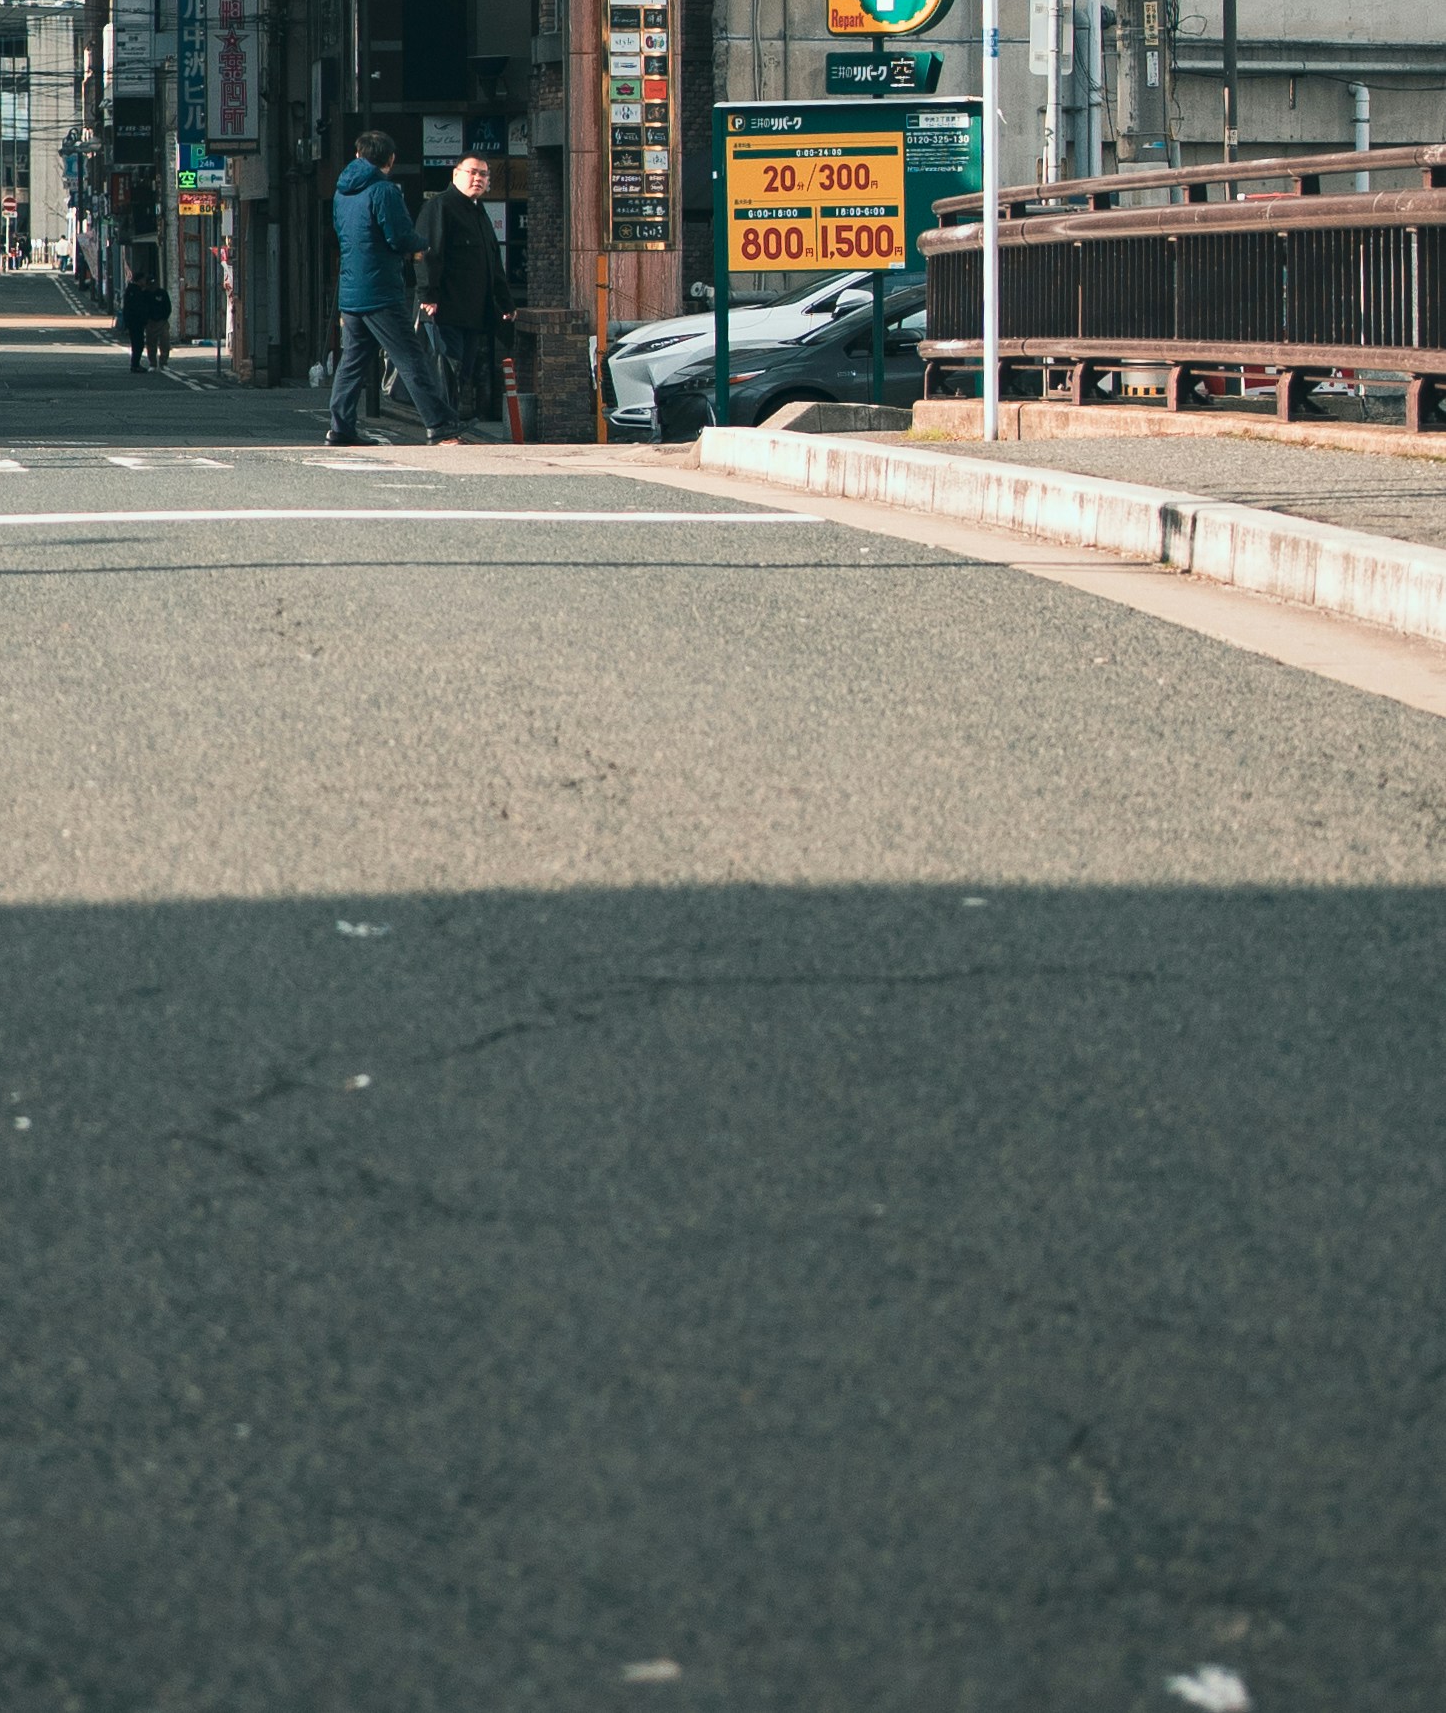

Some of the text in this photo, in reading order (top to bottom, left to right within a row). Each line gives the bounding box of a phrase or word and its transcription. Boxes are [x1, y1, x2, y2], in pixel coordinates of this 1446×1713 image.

[831, 8, 865, 30] Repark
[831, 65, 887, 82] 三井のリパーク
[750, 117, 802, 130] 三井のリパーク
[907, 134, 970, 144] 0120-325-130
[200, 160, 215, 168] 24h
[178, 170, 197, 188] 空
